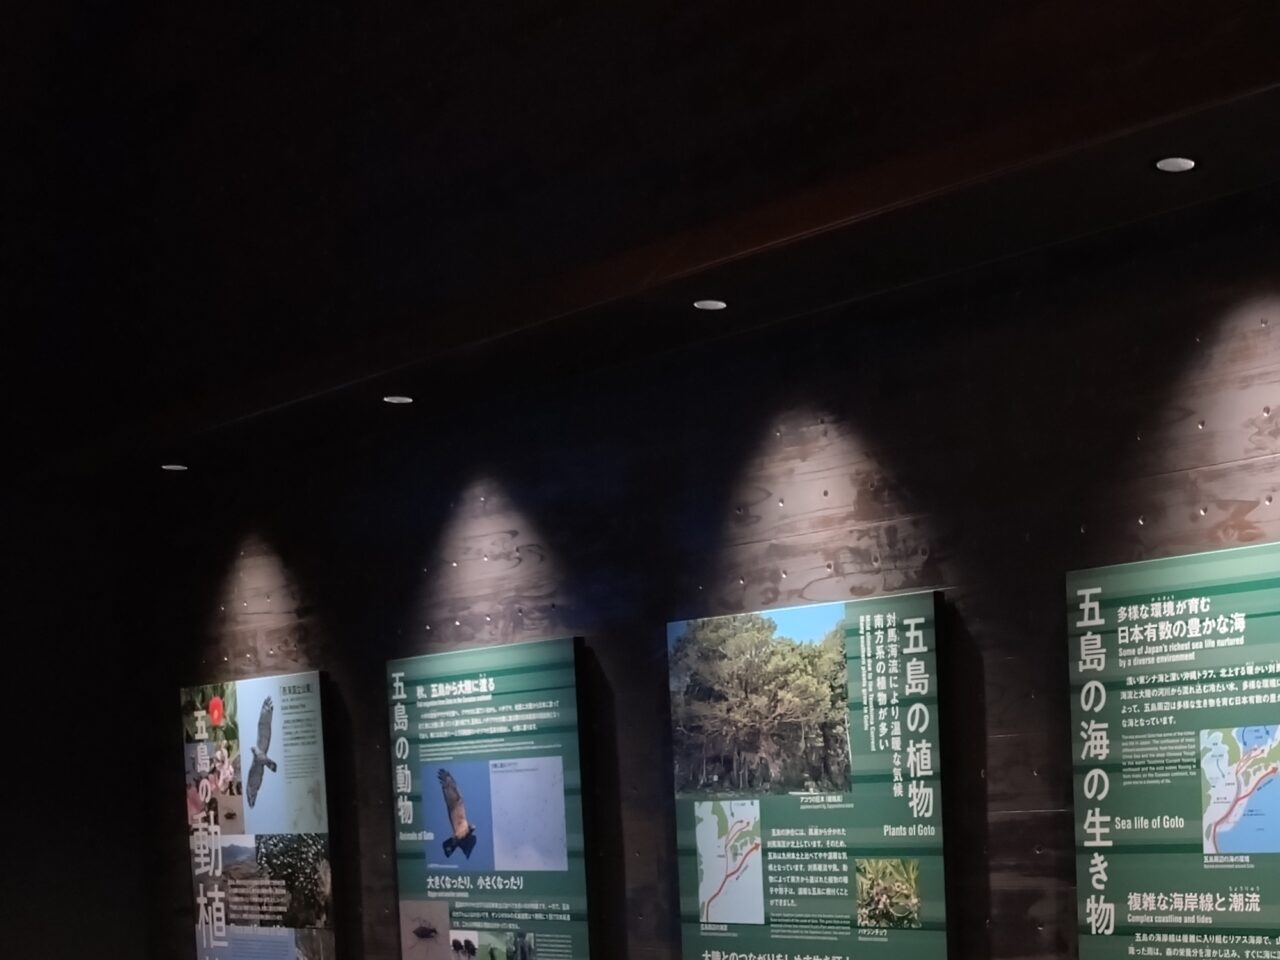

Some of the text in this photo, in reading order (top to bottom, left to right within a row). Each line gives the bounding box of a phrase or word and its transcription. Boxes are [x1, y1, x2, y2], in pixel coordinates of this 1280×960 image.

[1117, 597, 1210, 623] 多様な環境が育む
[1117, 612, 1246, 645] 日本有数の豊かな海
[874, 614, 889, 752] 南方系の植物が多い
[886, 612, 903, 798] 対馬海流により温暖な気候
[903, 616, 934, 818] 五島の植物
[391, 672, 413, 824] 五島の動物
[1076, 587, 1115, 935] 五島の海の生き物
[884, 824, 935, 837] Plants of Goto
[1115, 816, 1184, 829] Sea life of Goto
[427, 876, 524, 890] 大きくなったり、小さくなったり
[1127, 892, 1260, 912] 複雑な海岸線と潮流
[1127, 914, 1154, 925] Complex
